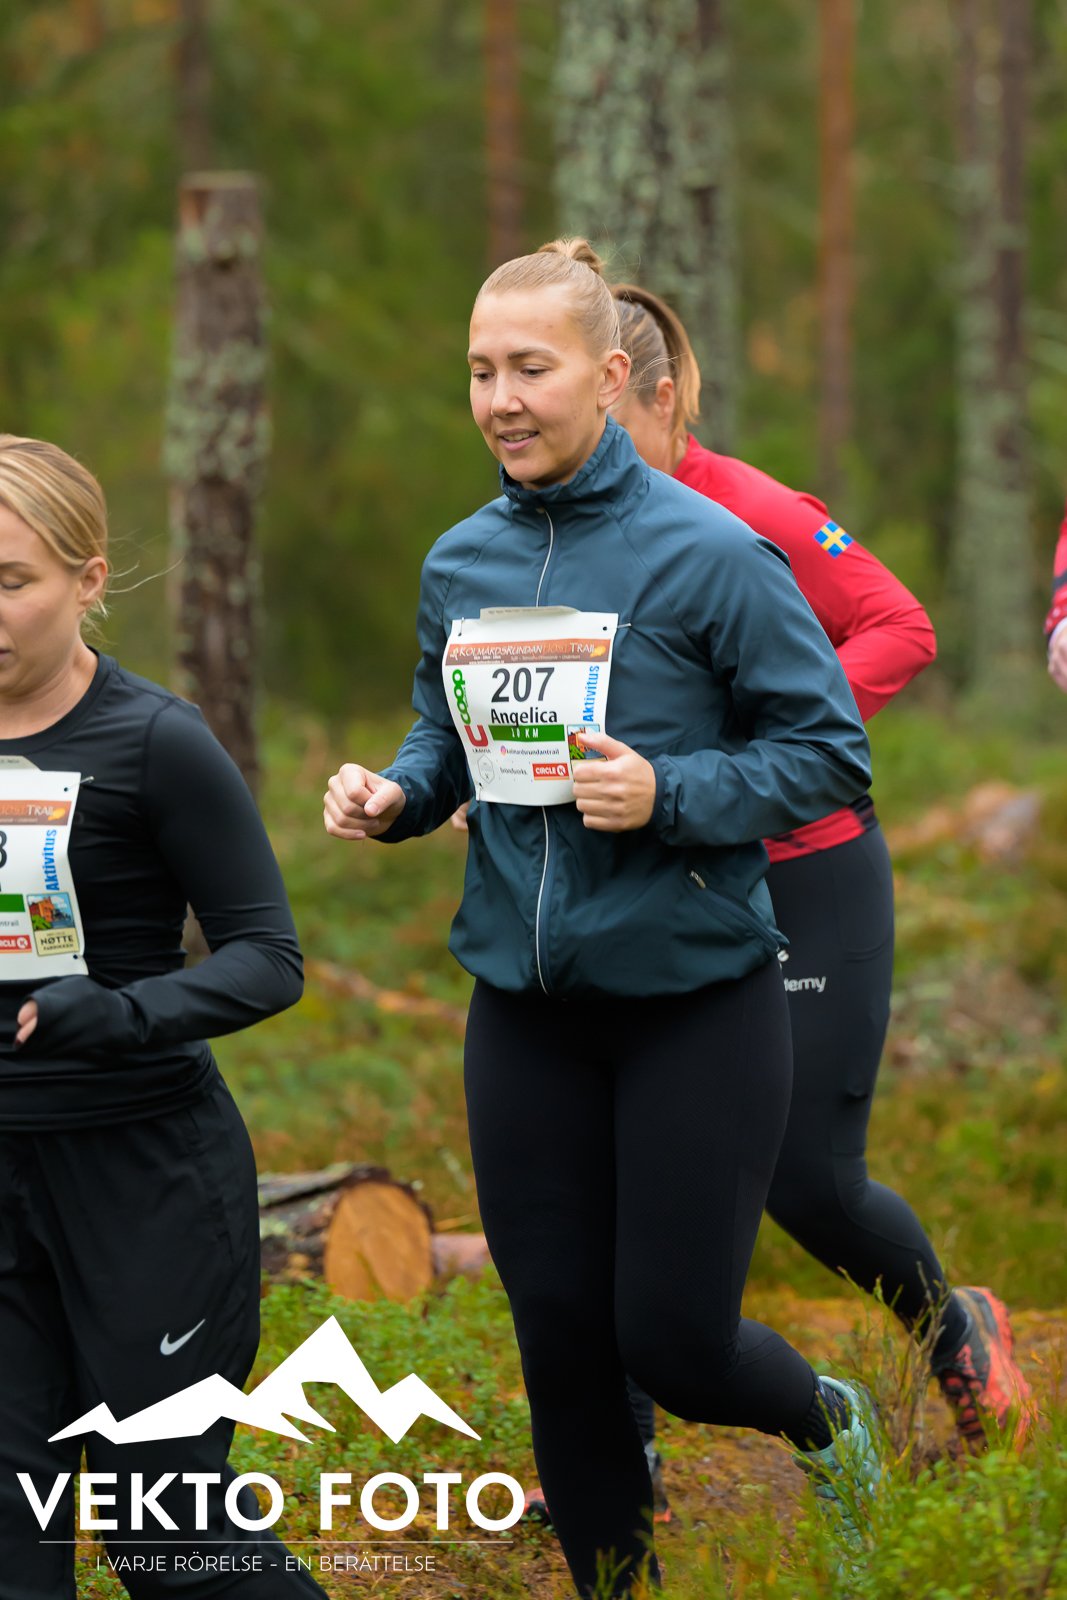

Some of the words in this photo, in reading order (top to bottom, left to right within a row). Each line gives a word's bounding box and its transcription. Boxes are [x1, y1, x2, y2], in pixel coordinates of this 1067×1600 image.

[452, 669, 471, 725] coop
[491, 667, 555, 703] 207
[582, 665, 600, 722] Aktivitus
[491, 707, 558, 728] Angelica
[525, 728, 539, 739] KM
[535, 766, 556, 775] CIRCLE
[42, 829, 60, 891] Aktivitus
